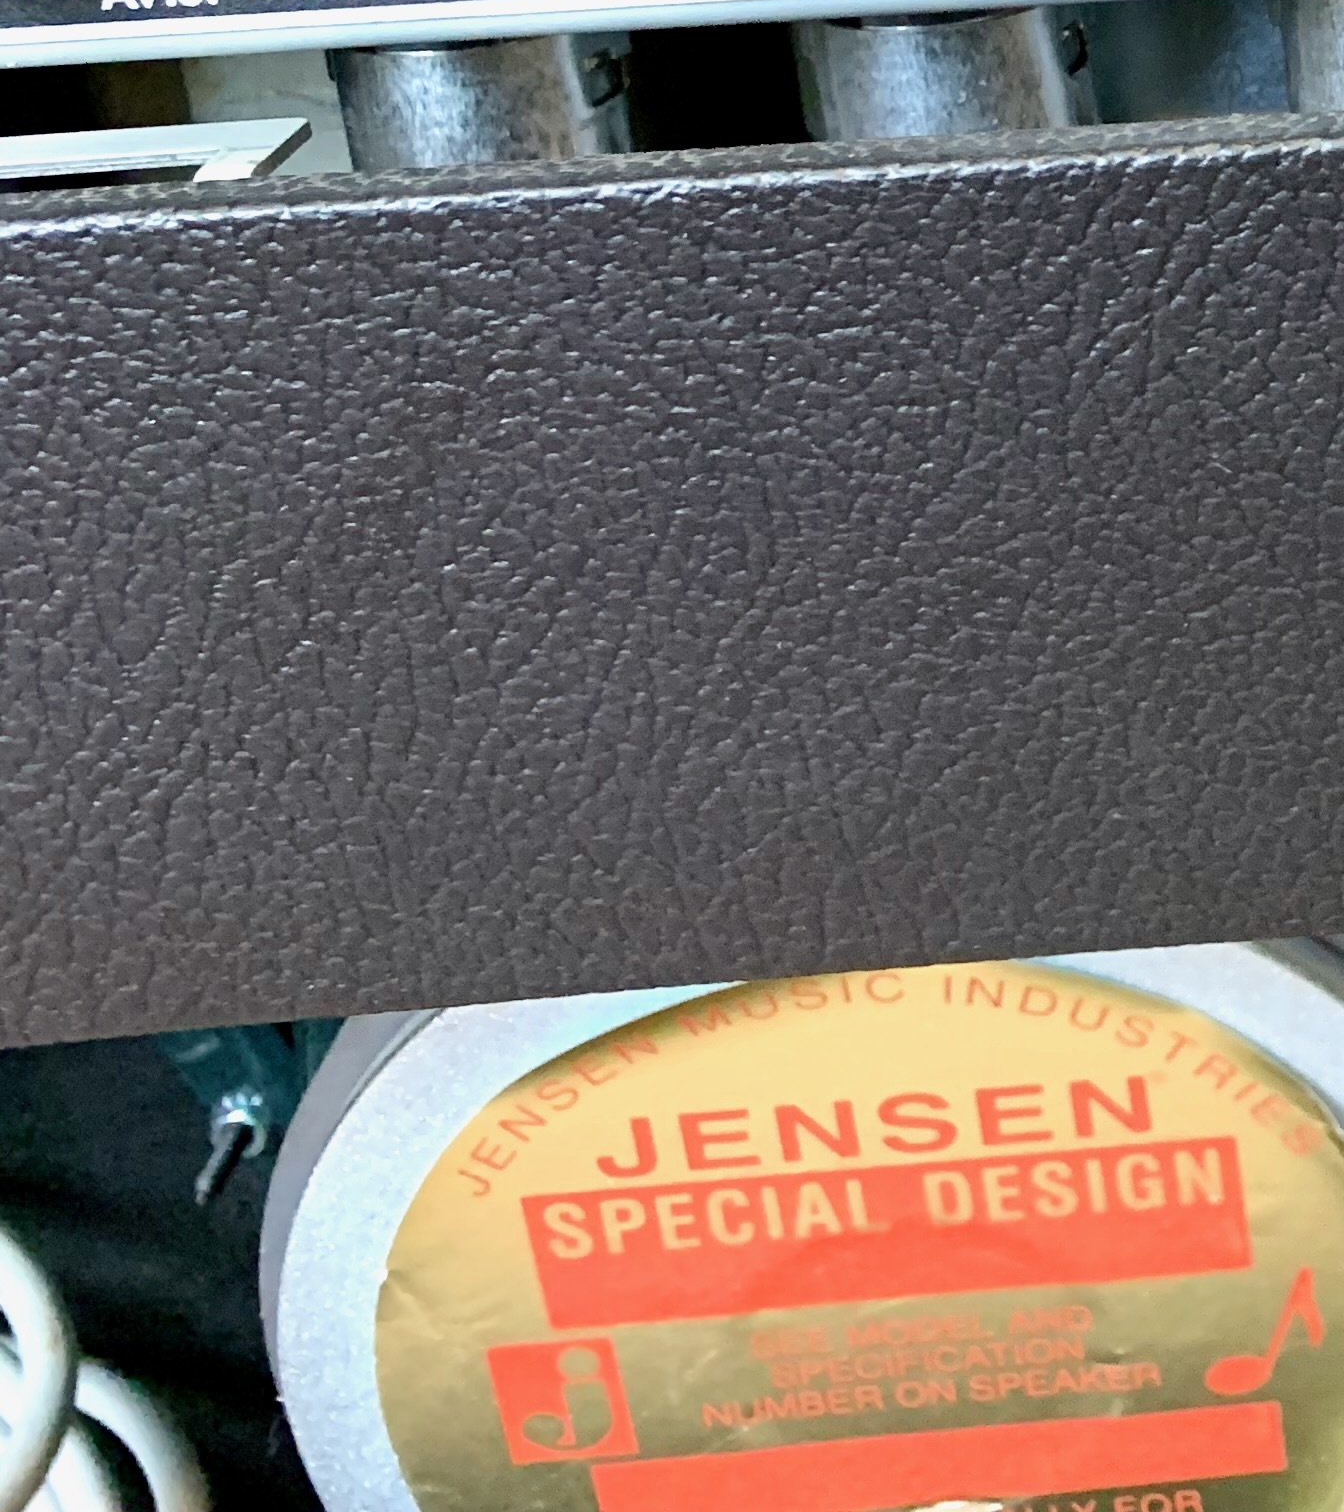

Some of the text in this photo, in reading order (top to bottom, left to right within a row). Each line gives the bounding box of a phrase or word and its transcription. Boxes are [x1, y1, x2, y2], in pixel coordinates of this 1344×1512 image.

[458, 970, 1324, 1199] JENSEN MUSIC INDUSTRIES
[596, 1075, 1153, 1179] JENSEN
[542, 1147, 1226, 1261] SPECIAL DESIGN
[750, 1305, 1094, 1360] SEE MODEL AND
[770, 1337, 1085, 1389] SPECIFICATION
[703, 1362, 1163, 1428] NUMBER ON SPEAKER
